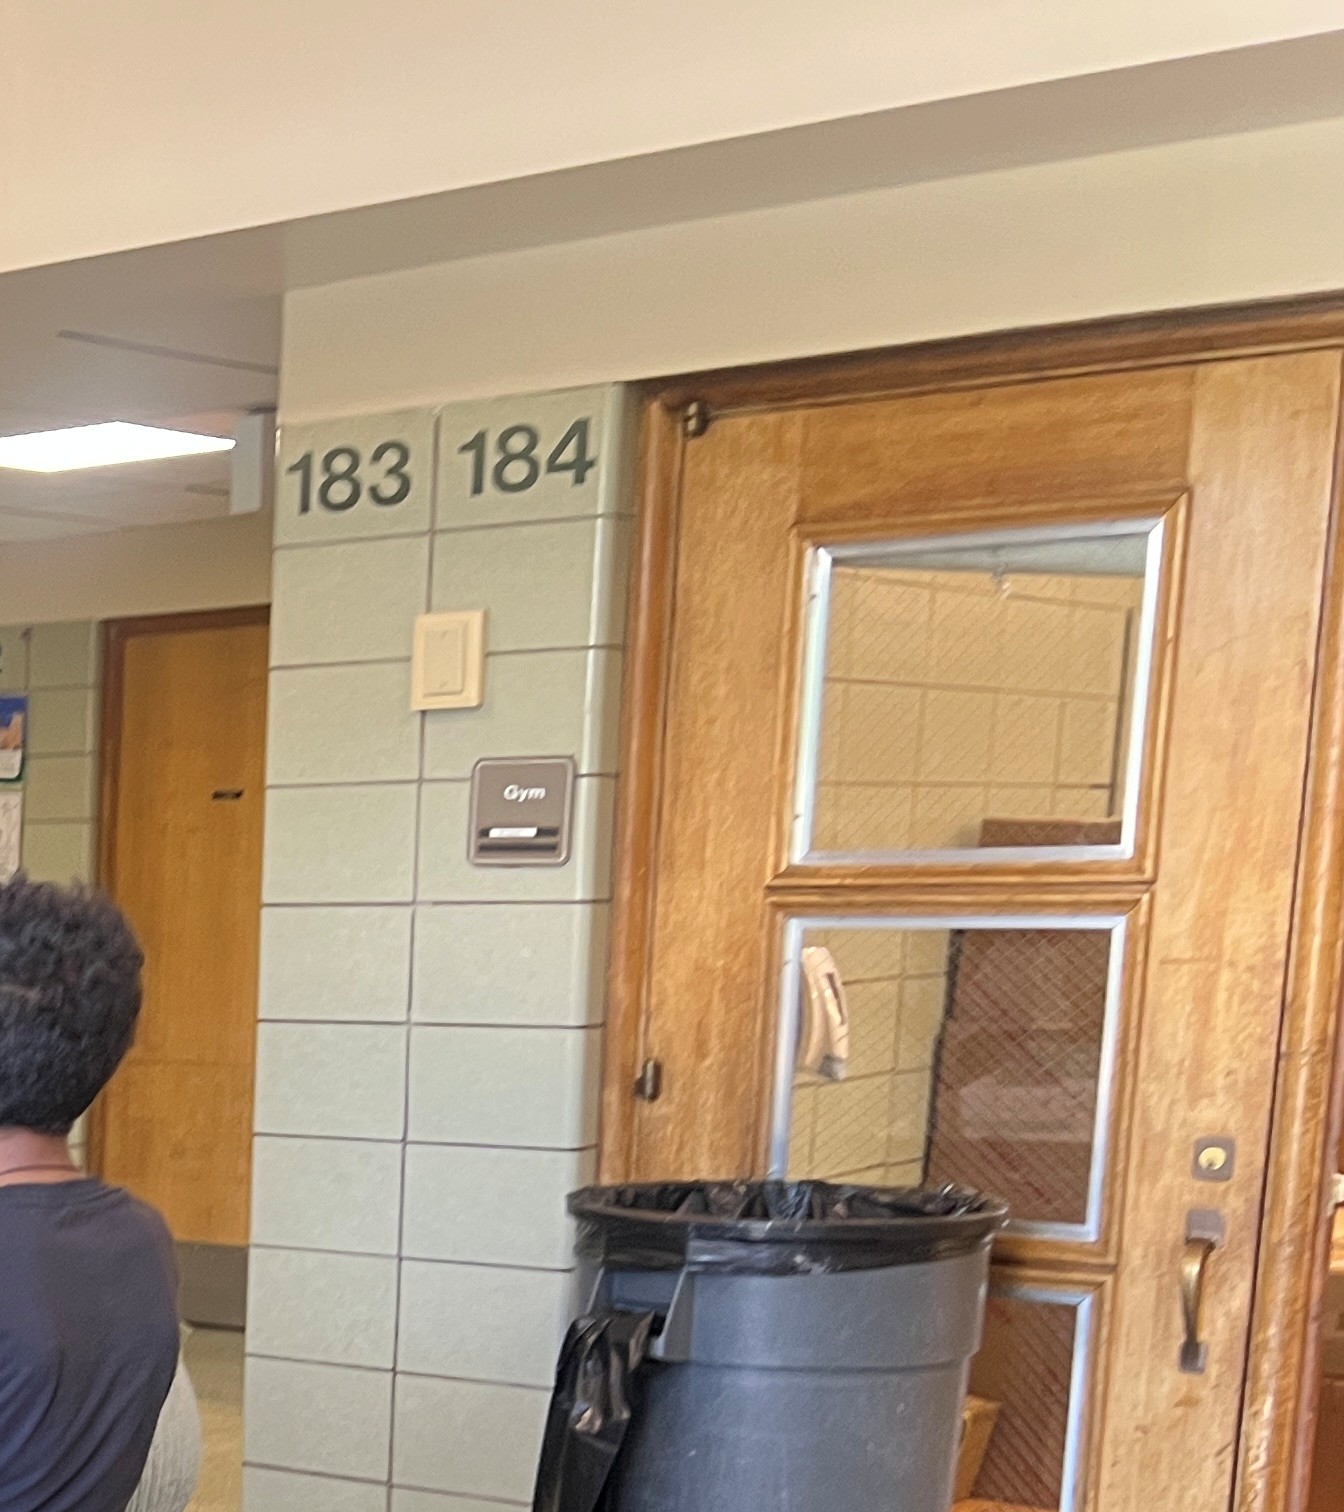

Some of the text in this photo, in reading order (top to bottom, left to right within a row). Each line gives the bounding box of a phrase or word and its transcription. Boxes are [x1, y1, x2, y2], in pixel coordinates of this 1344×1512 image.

[287, 439, 412, 515] 183
[457, 416, 597, 498] 184
[502, 784, 546, 803] Gym
